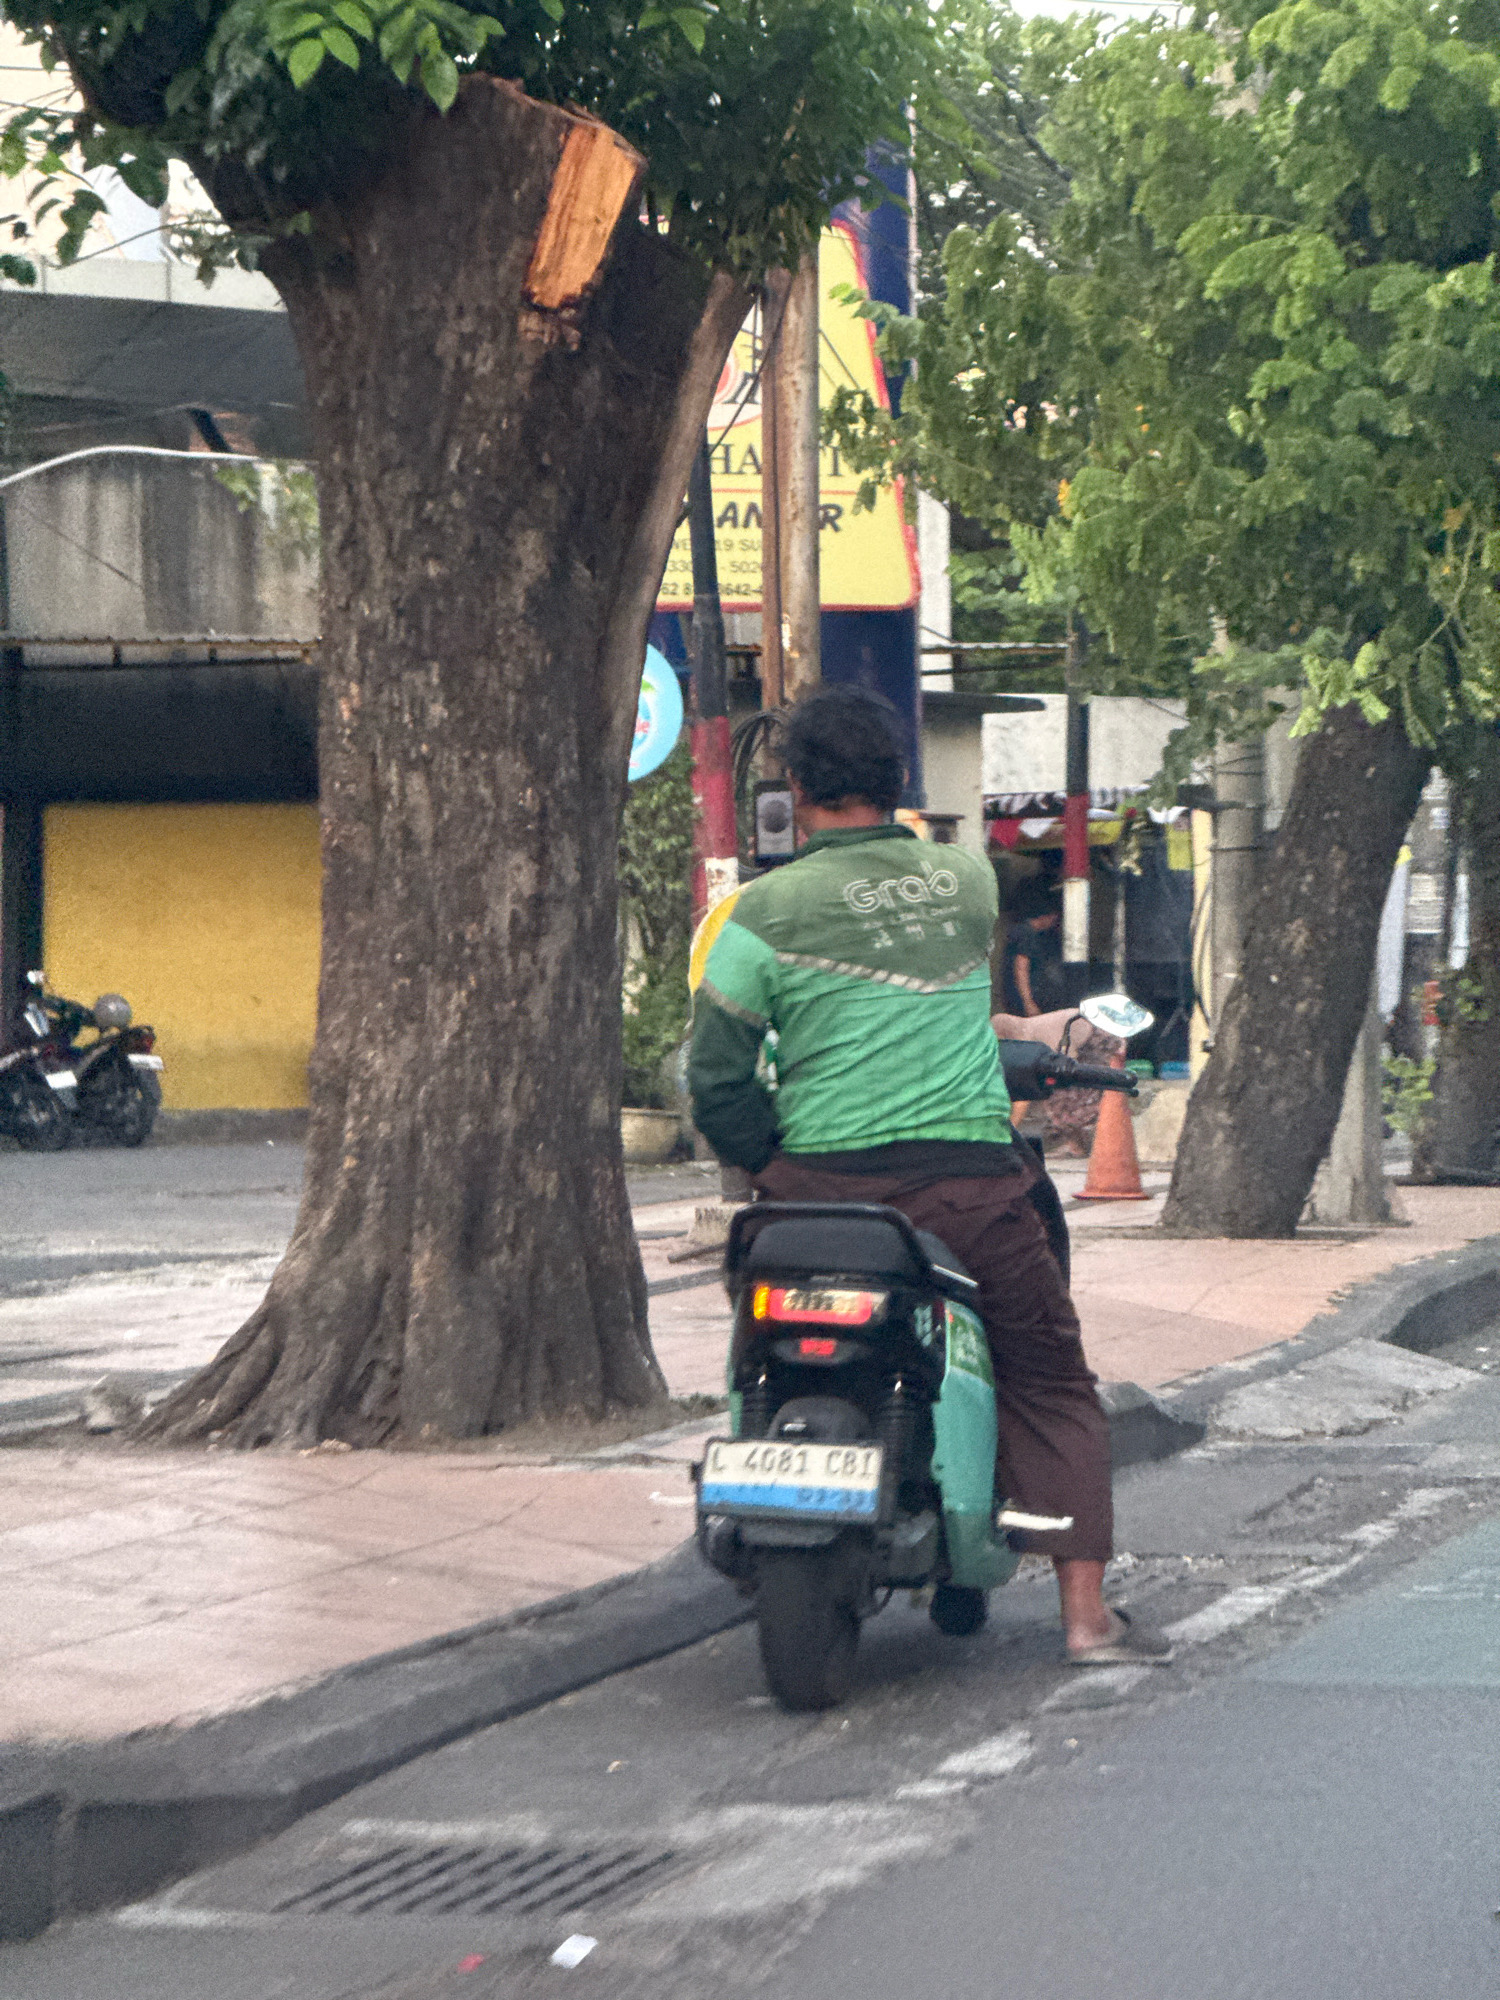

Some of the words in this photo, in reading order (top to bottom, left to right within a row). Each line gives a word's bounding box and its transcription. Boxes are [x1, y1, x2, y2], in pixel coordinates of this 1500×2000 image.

[843, 860, 958, 913] Grab
[711, 1446, 726, 1474] L
[743, 1446, 808, 1476] 4081
